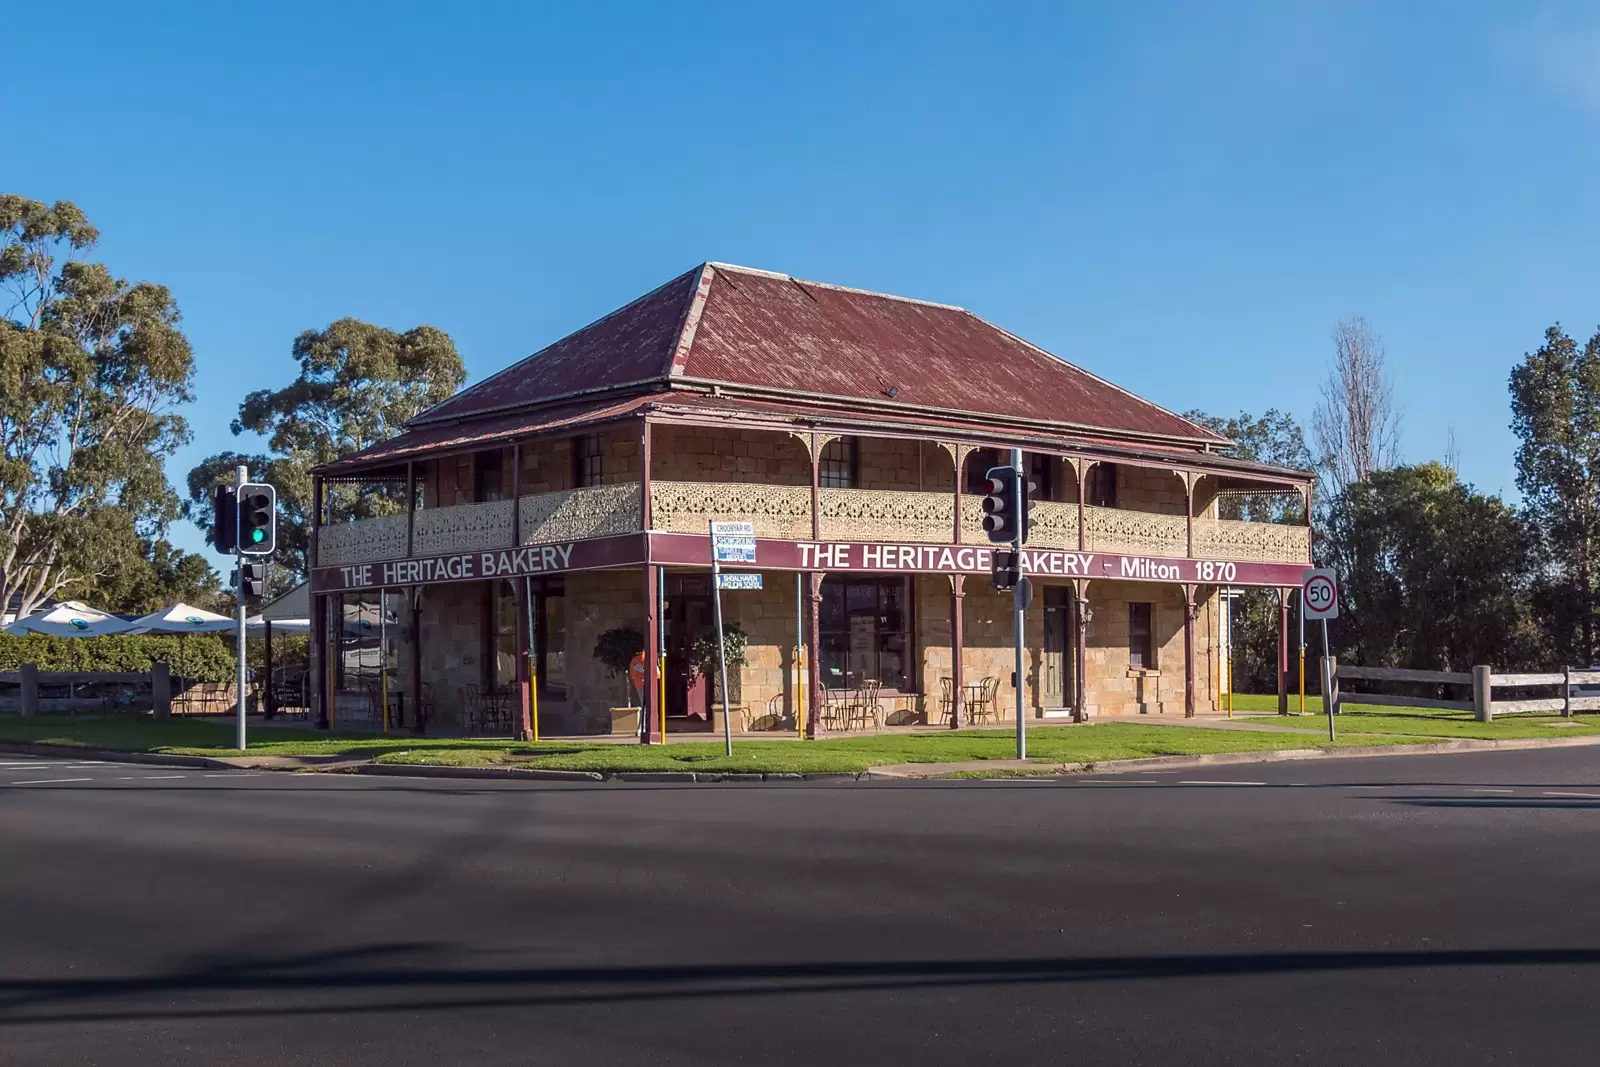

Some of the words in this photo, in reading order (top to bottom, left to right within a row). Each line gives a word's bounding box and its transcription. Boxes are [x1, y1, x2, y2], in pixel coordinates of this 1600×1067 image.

[744, 524, 752, 532] RD
[340, 565, 373, 588] THE
[383, 555, 474, 584] HERITAGE
[481, 543, 574, 576] BAKERY
[797, 543, 850, 568] THE
[862, 545, 991, 570] HERITAGE
[1020, 551, 1094, 575] AKERY
[1121, 557, 1180, 580] Milton
[1195, 561, 1237, 582] 1870
[1310, 586, 1330, 602] 50
